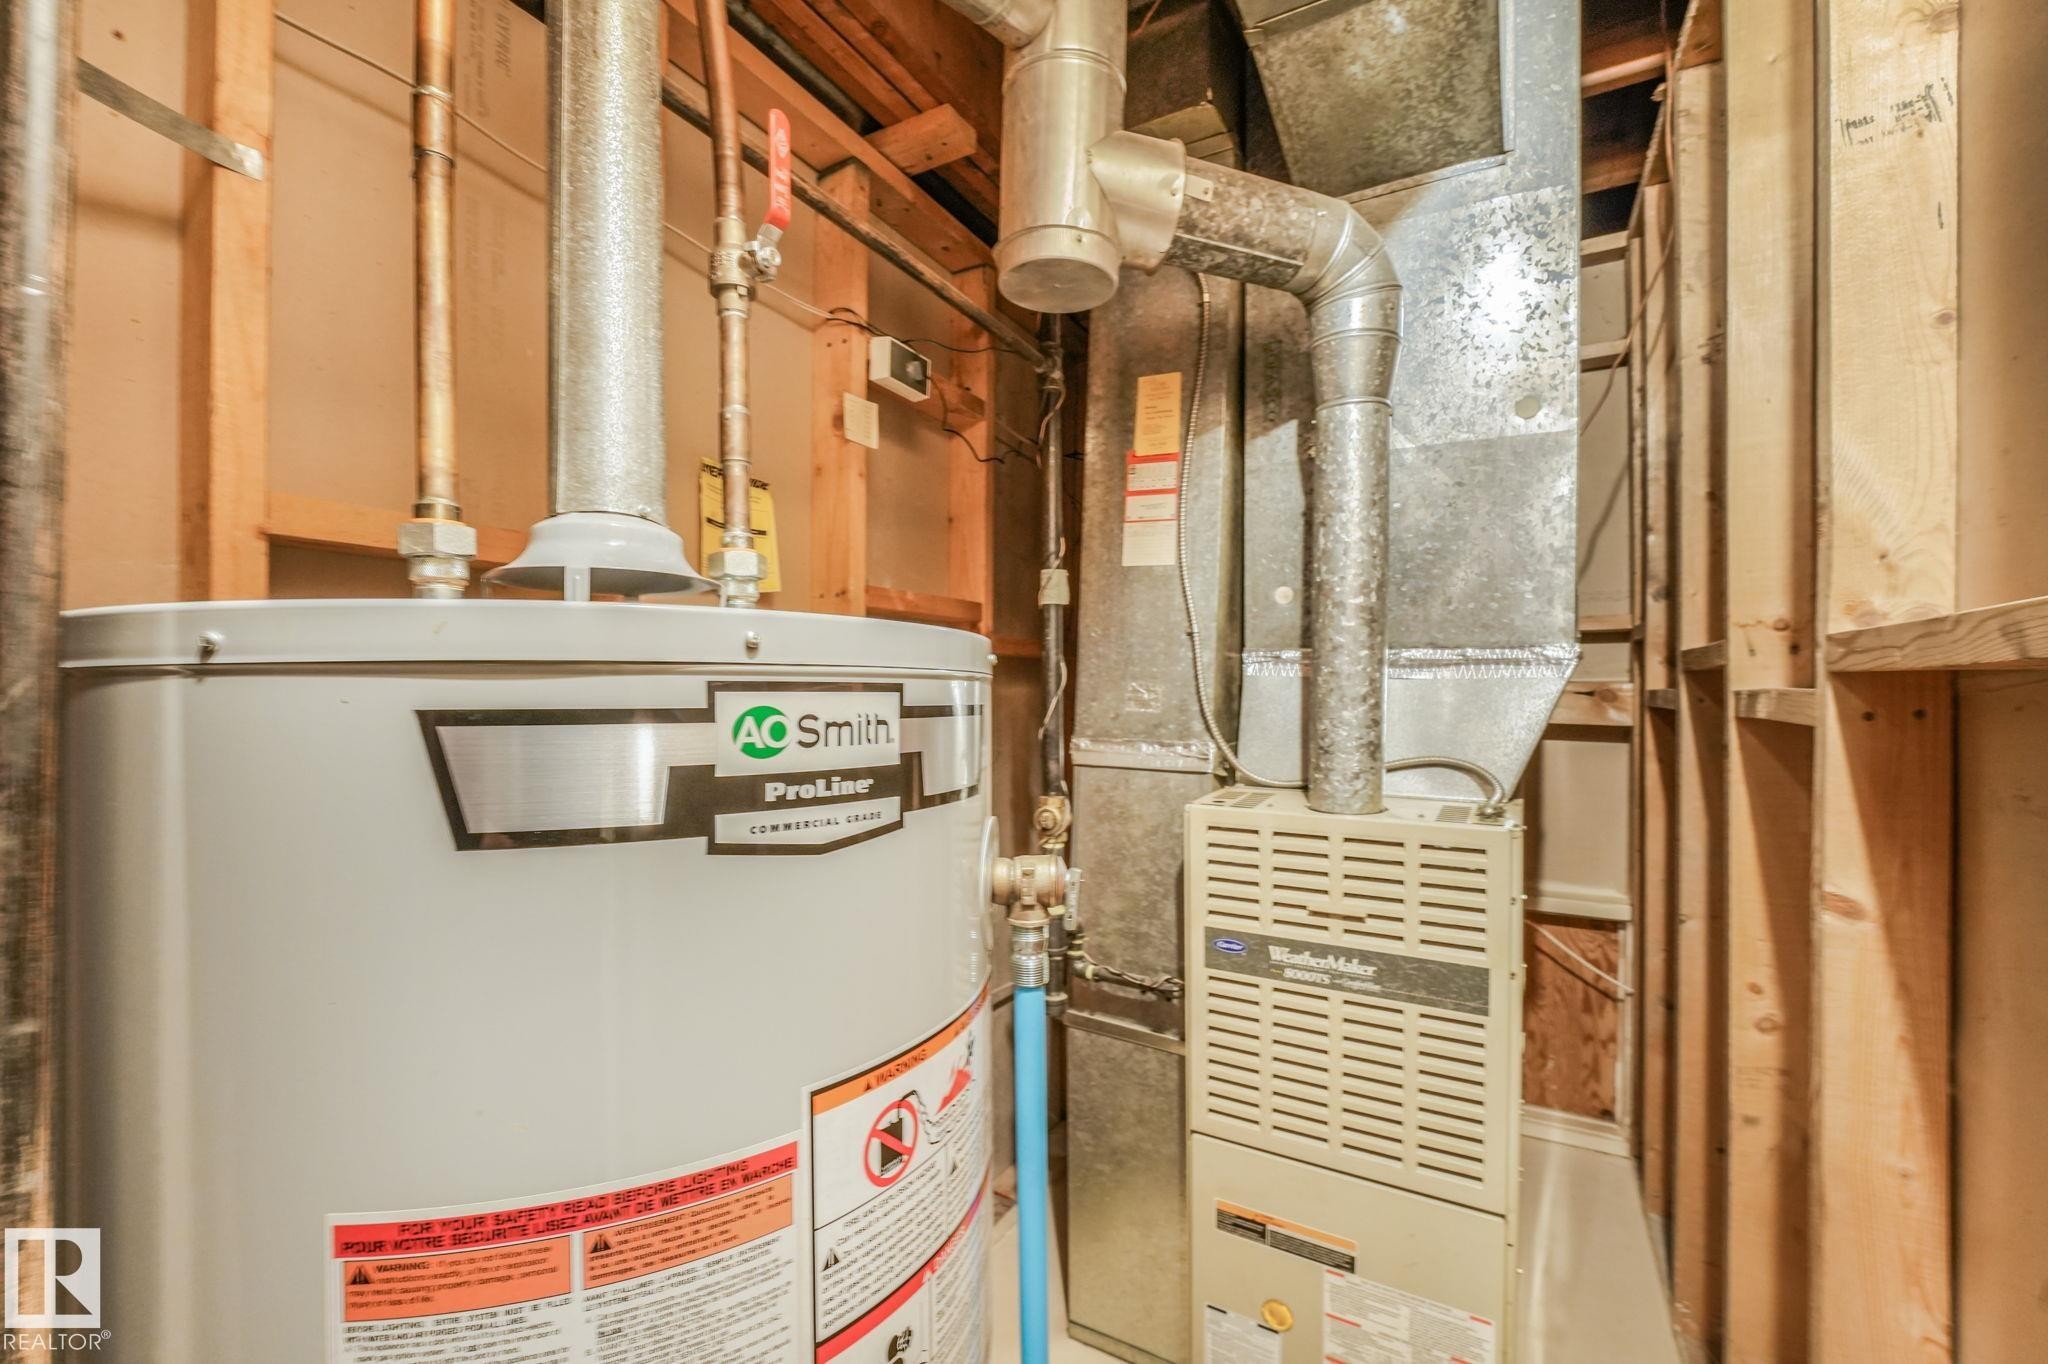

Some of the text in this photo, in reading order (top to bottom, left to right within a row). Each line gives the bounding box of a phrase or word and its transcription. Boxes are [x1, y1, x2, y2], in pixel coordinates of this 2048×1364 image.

[732, 710, 892, 753] AO Smith
[764, 776, 873, 802] ProLine
[750, 811, 882, 835] COMMERCIAL GRADE
[1268, 945, 1378, 976] WeatherMaker
[494, 1206, 556, 1226] SAFETY
[564, 1194, 608, 1214] READ
[614, 1180, 677, 1204] BEFORE
